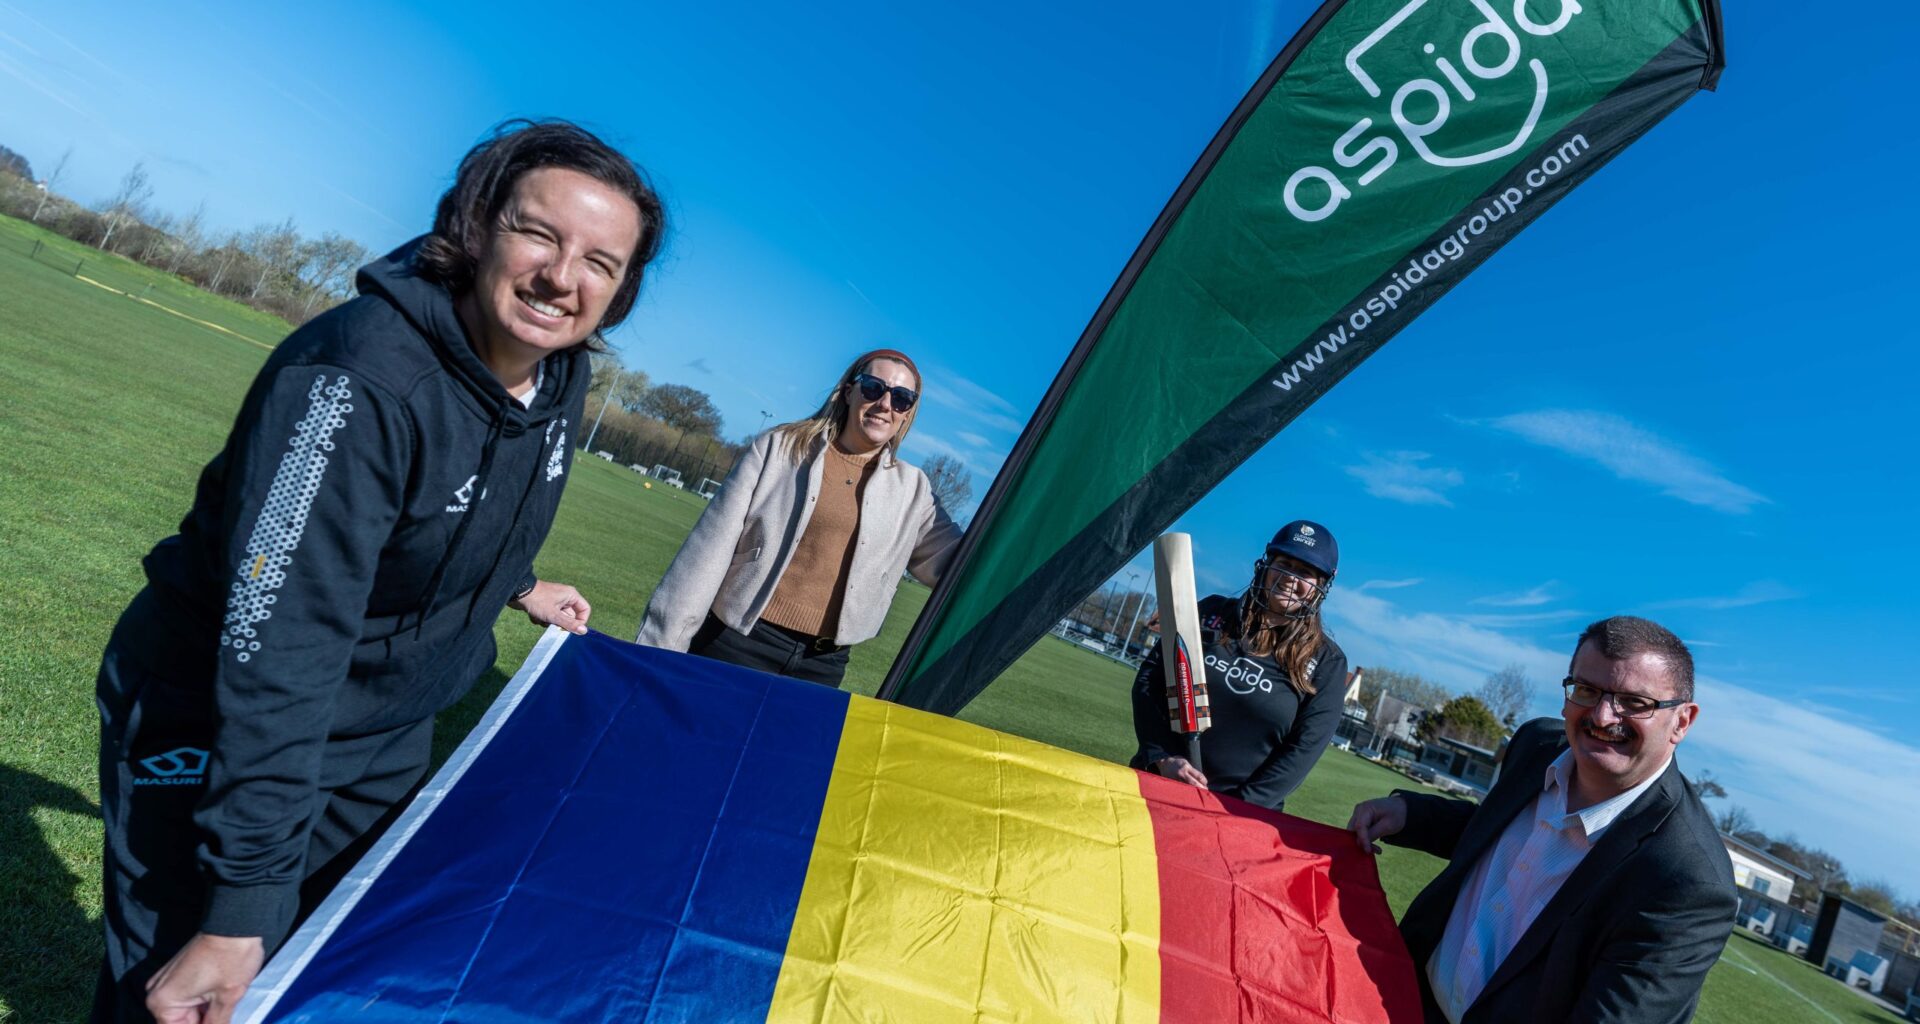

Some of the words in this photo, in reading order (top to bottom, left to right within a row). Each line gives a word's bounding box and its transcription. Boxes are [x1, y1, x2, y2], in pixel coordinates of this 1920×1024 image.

[1283, 0, 1583, 222] aspida
[1272, 132, 1590, 392] www.aspidagroup.com
[1204, 655, 1273, 694] aspida
[133, 777, 204, 785] MASURI
